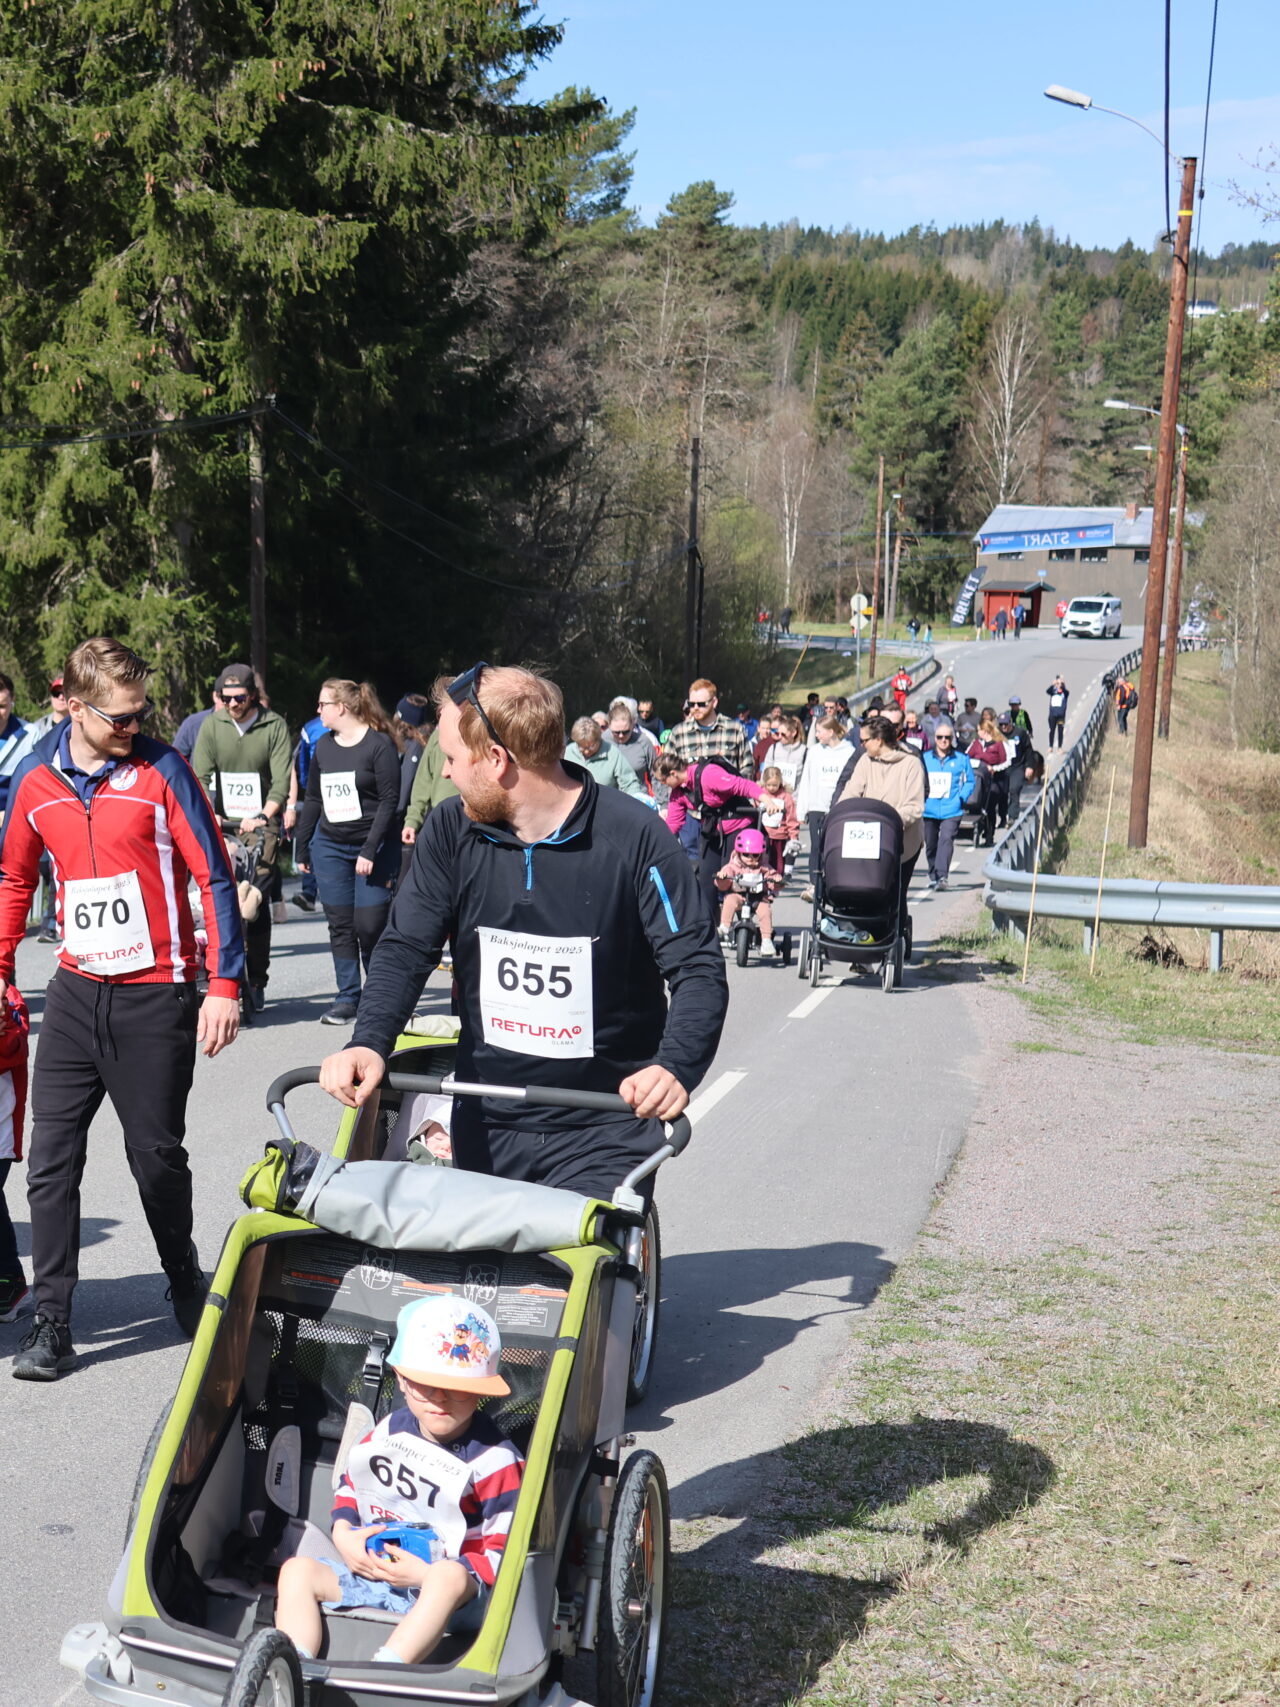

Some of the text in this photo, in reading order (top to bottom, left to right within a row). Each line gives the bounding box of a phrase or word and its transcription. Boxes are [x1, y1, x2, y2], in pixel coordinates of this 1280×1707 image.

[952, 574, 980, 624] BRUKET
[227, 783, 254, 796] 729
[325, 784, 351, 798] 730
[74, 898, 130, 930] 670
[555, 946, 584, 954] 2025
[497, 957, 573, 999] 655
[491, 1017, 573, 1039] RETURA
[368, 1455, 441, 1508] 657
